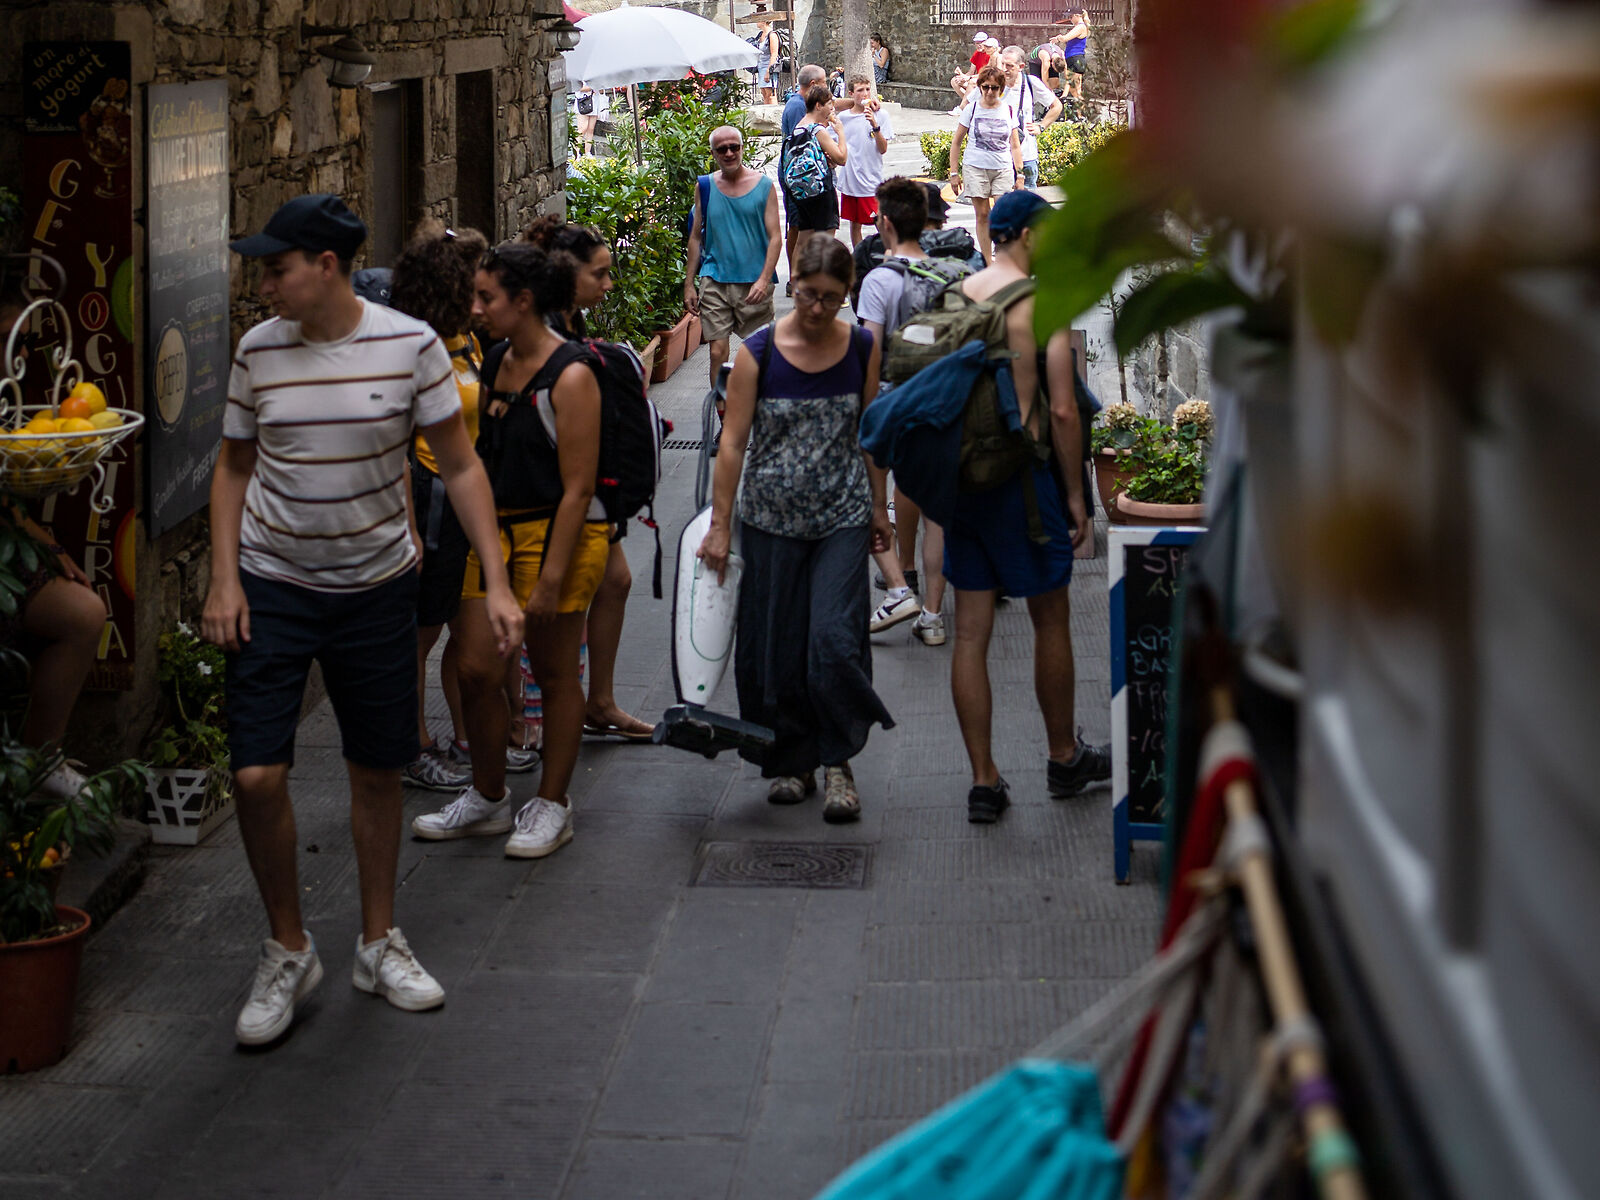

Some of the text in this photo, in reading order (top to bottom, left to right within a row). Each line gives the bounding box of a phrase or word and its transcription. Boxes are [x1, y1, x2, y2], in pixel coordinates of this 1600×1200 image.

[32, 52, 77, 91] mare
[33, 48, 56, 69] un
[40, 53, 105, 118] yogurt
[163, 138, 186, 185] MARE
[198, 131, 226, 178] YOGURT
[193, 452, 210, 492] FREE
